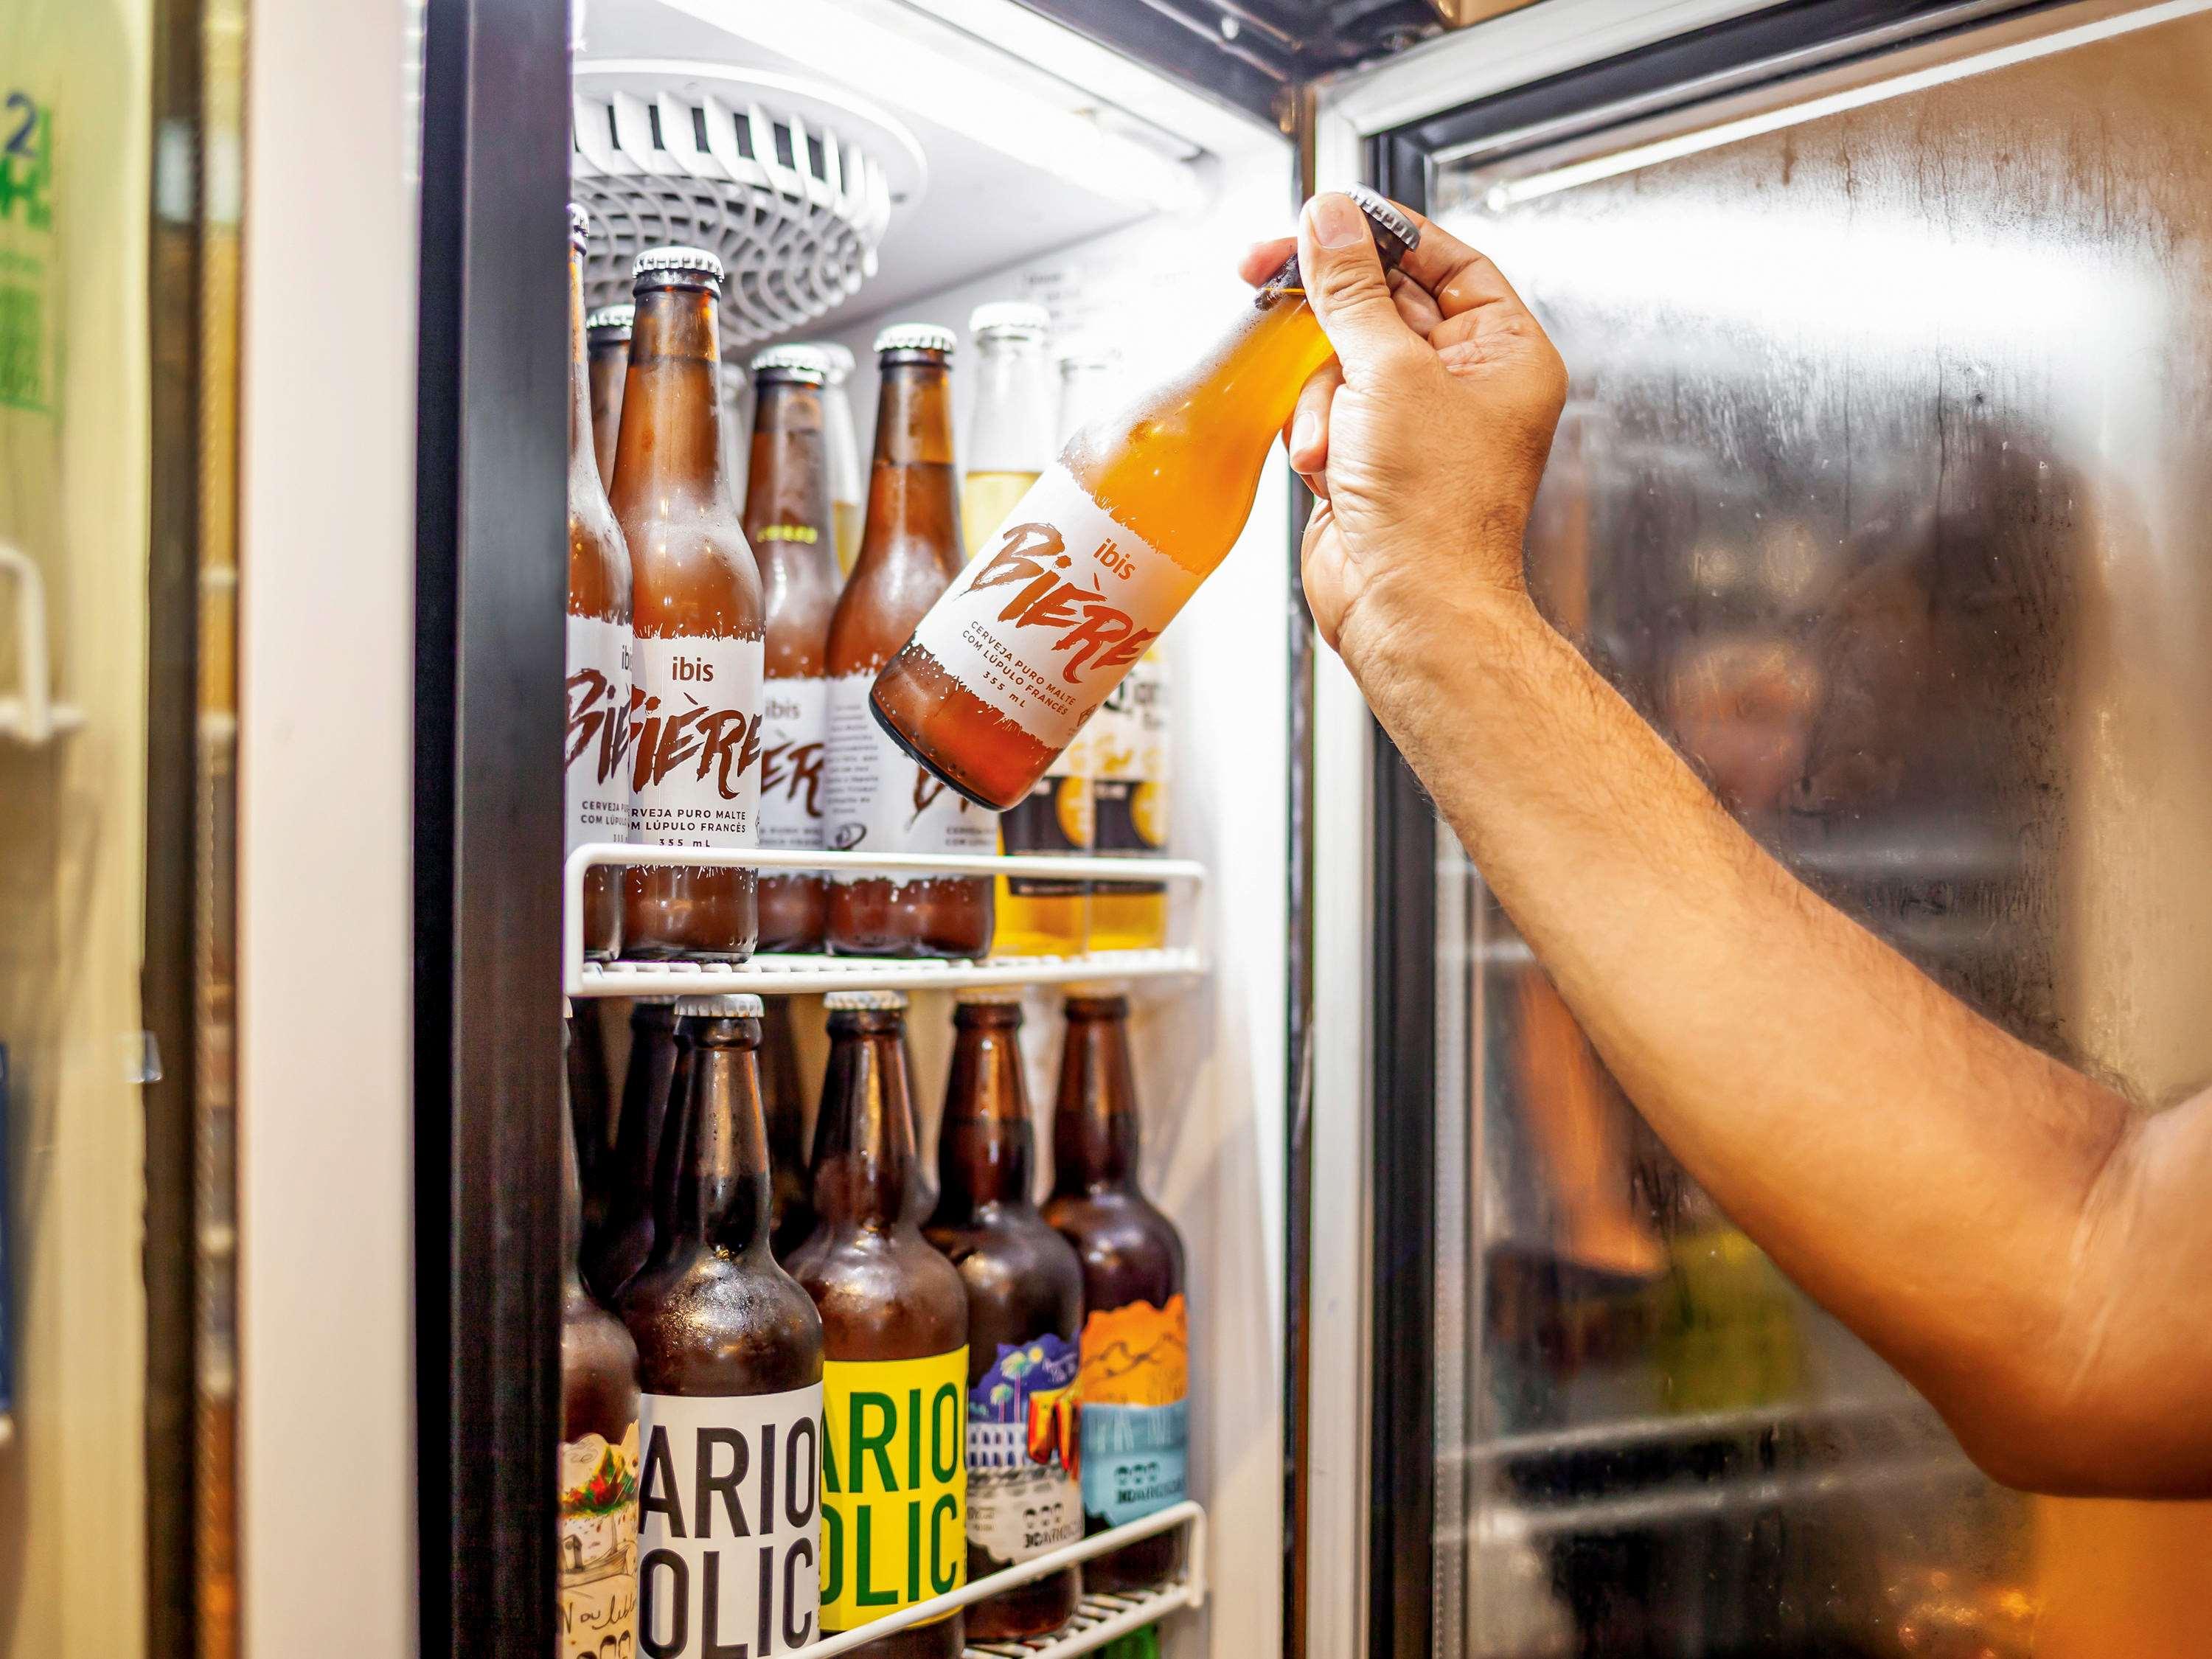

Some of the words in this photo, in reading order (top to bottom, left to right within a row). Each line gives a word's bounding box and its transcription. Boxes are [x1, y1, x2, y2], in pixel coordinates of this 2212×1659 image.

[1091, 538, 1137, 581] ibis
[672, 655, 714, 682] ibis
[962, 630, 984, 651] COM
[983, 649, 1024, 686] LÚPULO
[970, 620, 1013, 662] CERVEJA
[1015, 660, 1045, 685] PURO
[1046, 683, 1077, 706] MALTE
[982, 670, 1006, 691] 355
[1009, 692, 1026, 708] mL
[580, 814, 602, 824] COM
[628, 808, 672, 818] RVEJA
[678, 809, 712, 818] PURO
[716, 810, 746, 820] MALTE
[646, 819, 695, 831] LÚPULO
[659, 838, 684, 846] 355
[692, 839, 711, 847] mL
